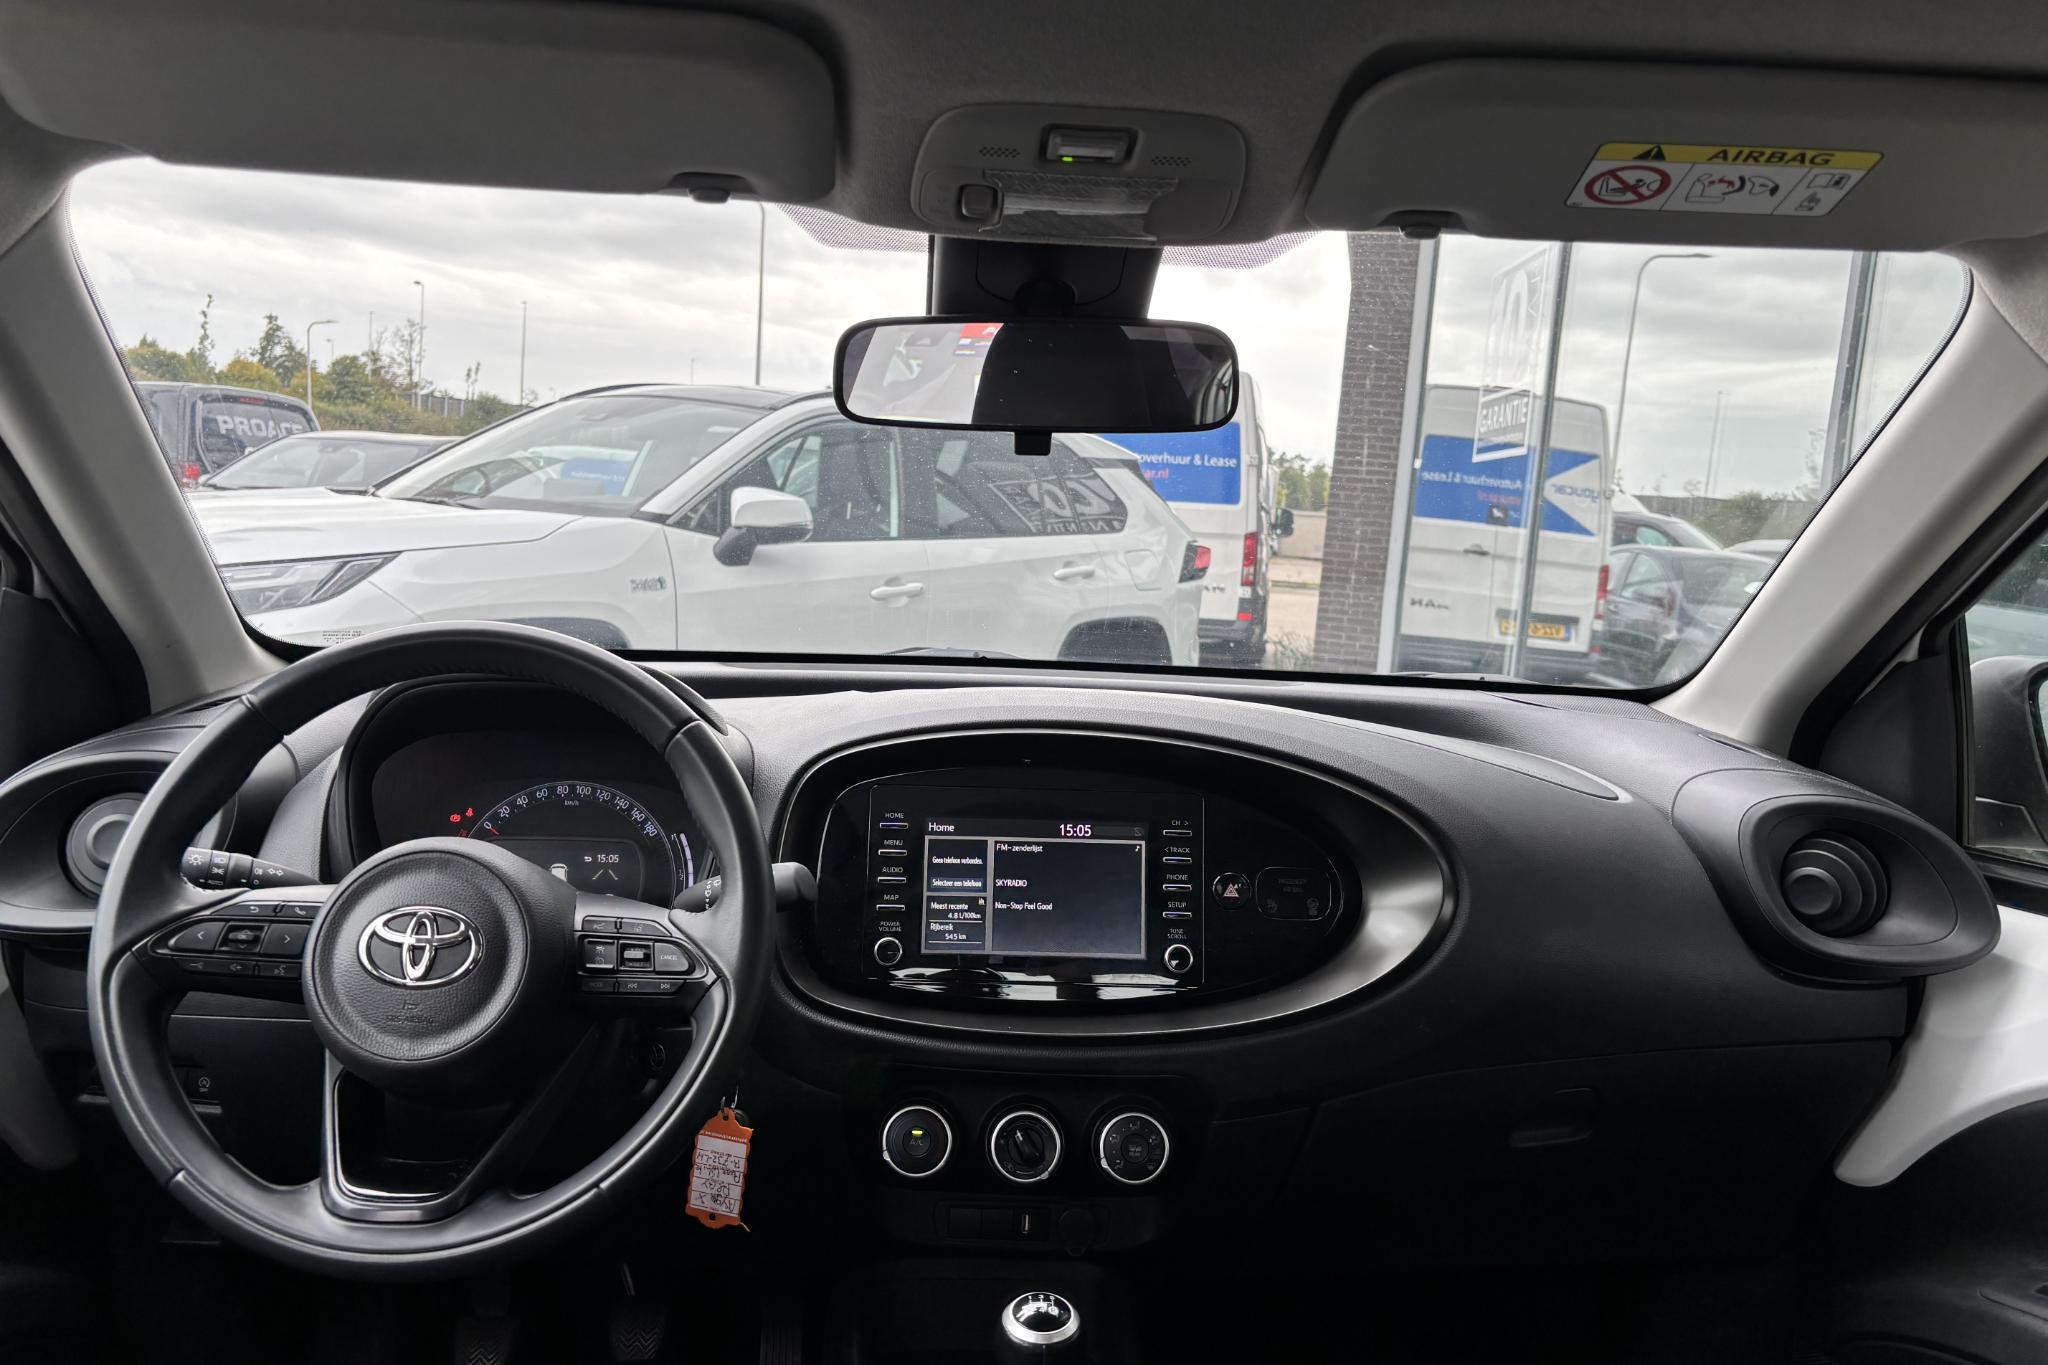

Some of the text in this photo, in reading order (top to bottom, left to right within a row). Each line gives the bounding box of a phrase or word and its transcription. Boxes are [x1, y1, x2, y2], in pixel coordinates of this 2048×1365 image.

[1706, 148, 1836, 167] AIRBAG
[1478, 398, 1530, 434] GARANTIE
[1193, 453, 1203, 466] &
[1204, 454, 1238, 468] Lease
[535, 788, 549, 798] 60
[556, 785, 569, 795] 80
[576, 785, 592, 795] 100
[596, 789, 611, 801] 120
[516, 795, 529, 806] 40
[614, 796, 630, 810] 140
[498, 806, 511, 818] 20
[630, 808, 645, 823] 160
[483, 821, 492, 830] 0
[644, 820, 659, 838] 180
[928, 822, 955, 832] Home
[1059, 824, 1092, 837] 15:05
[996, 843, 1043, 853] FM-zenderlijst
[597, 854, 619, 863] 15:05
[932, 856, 943, 865] Geen
[944, 857, 960, 865] telefoon
[932, 878, 953, 888] Selecteer
[962, 880, 982, 888] telefoon
[995, 879, 1028, 888] SKYRADIO
[930, 902, 948, 911] Meest
[995, 902, 1053, 911] Non-Stop Feel Good
[945, 933, 967, 941] 545 km
